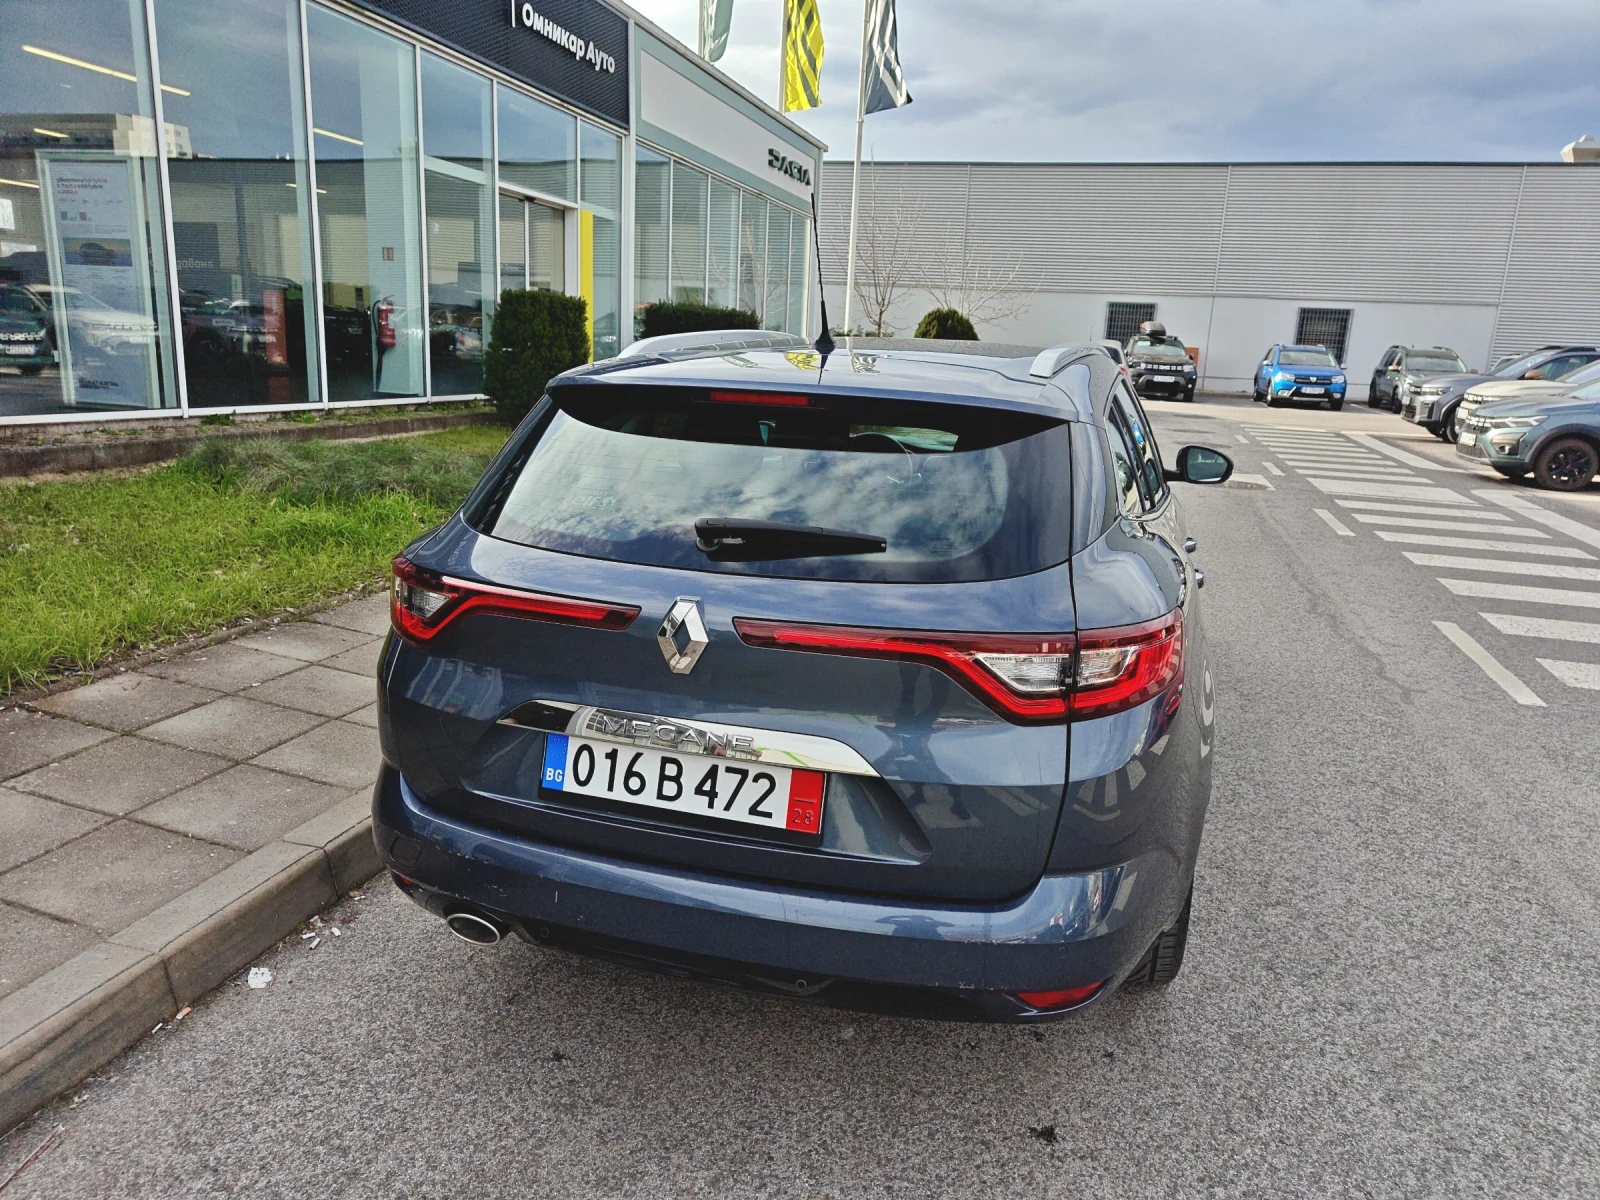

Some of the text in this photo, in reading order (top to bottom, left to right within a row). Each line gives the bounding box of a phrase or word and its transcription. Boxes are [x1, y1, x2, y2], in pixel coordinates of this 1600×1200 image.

[522, 2, 615, 73] Омникар Ауто
[768, 148, 811, 186] DACIA
[603, 715, 754, 751] MEGANE
[545, 767, 563, 782] BG
[792, 808, 814, 825] 28
